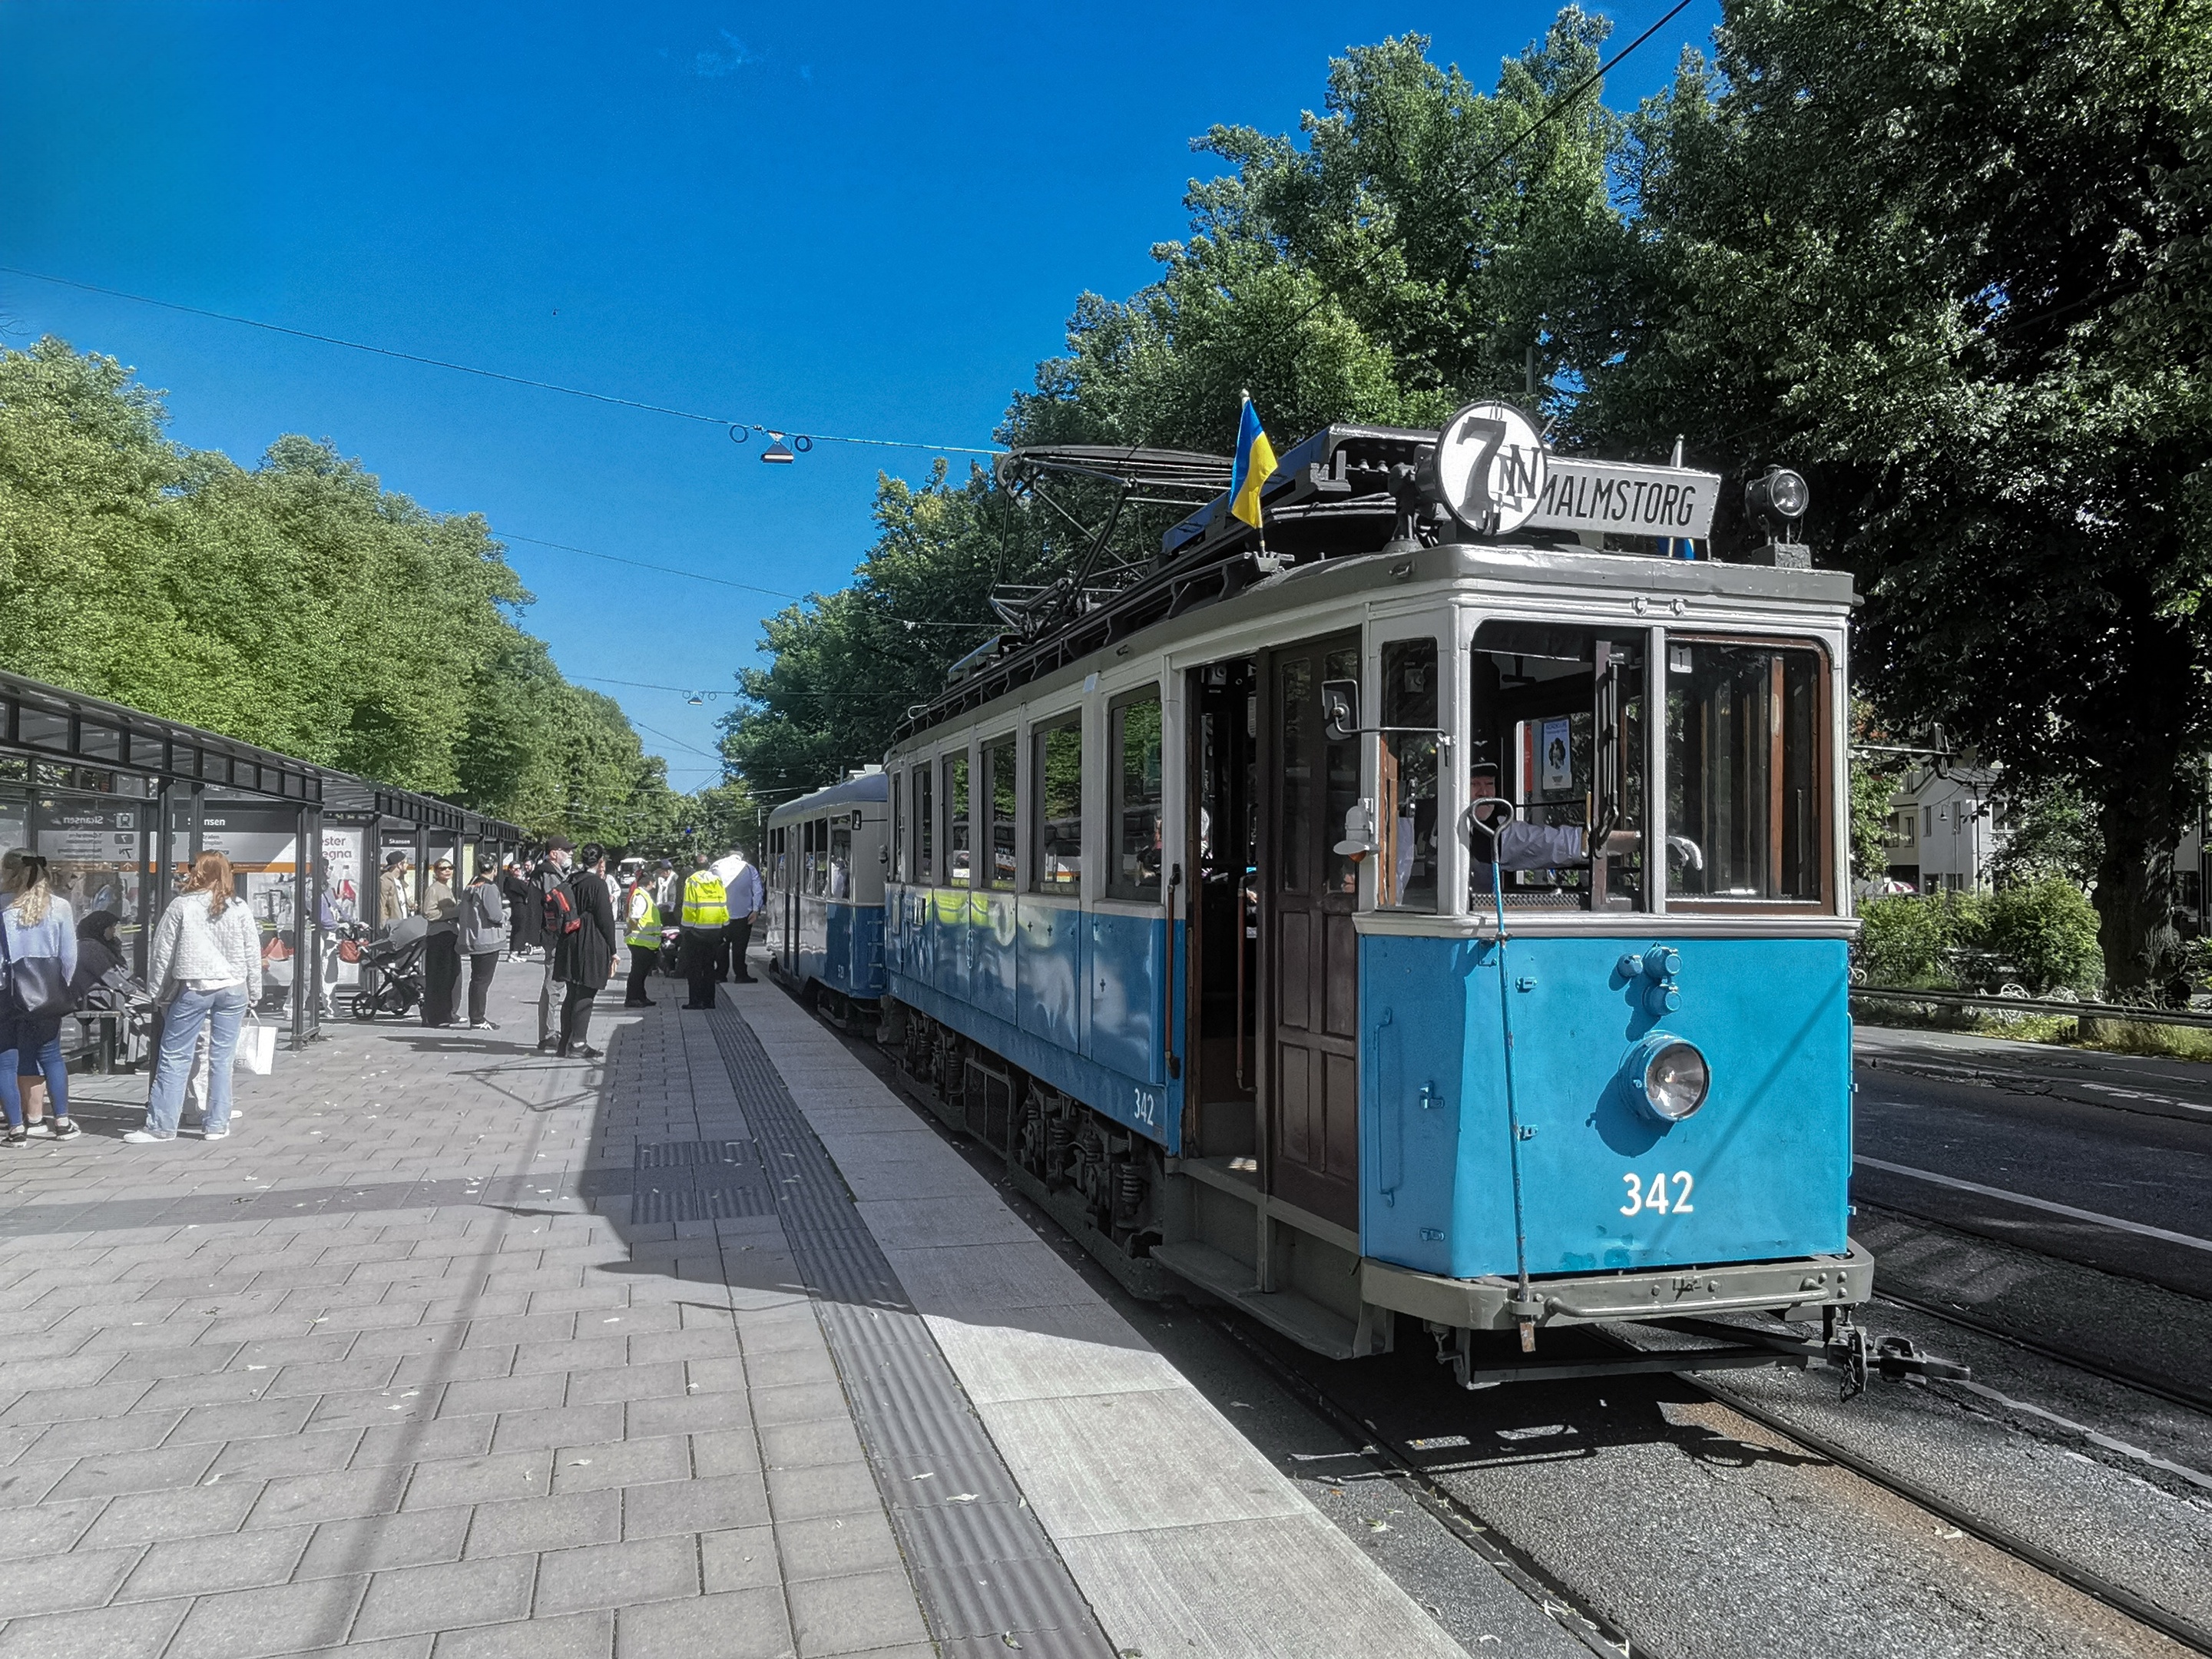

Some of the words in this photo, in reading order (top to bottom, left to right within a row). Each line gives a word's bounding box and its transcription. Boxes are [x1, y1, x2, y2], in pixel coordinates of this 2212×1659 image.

[323, 836, 346, 846] ster
[1134, 1088, 1154, 1127] 342
[1620, 1170, 1694, 1216] 342
